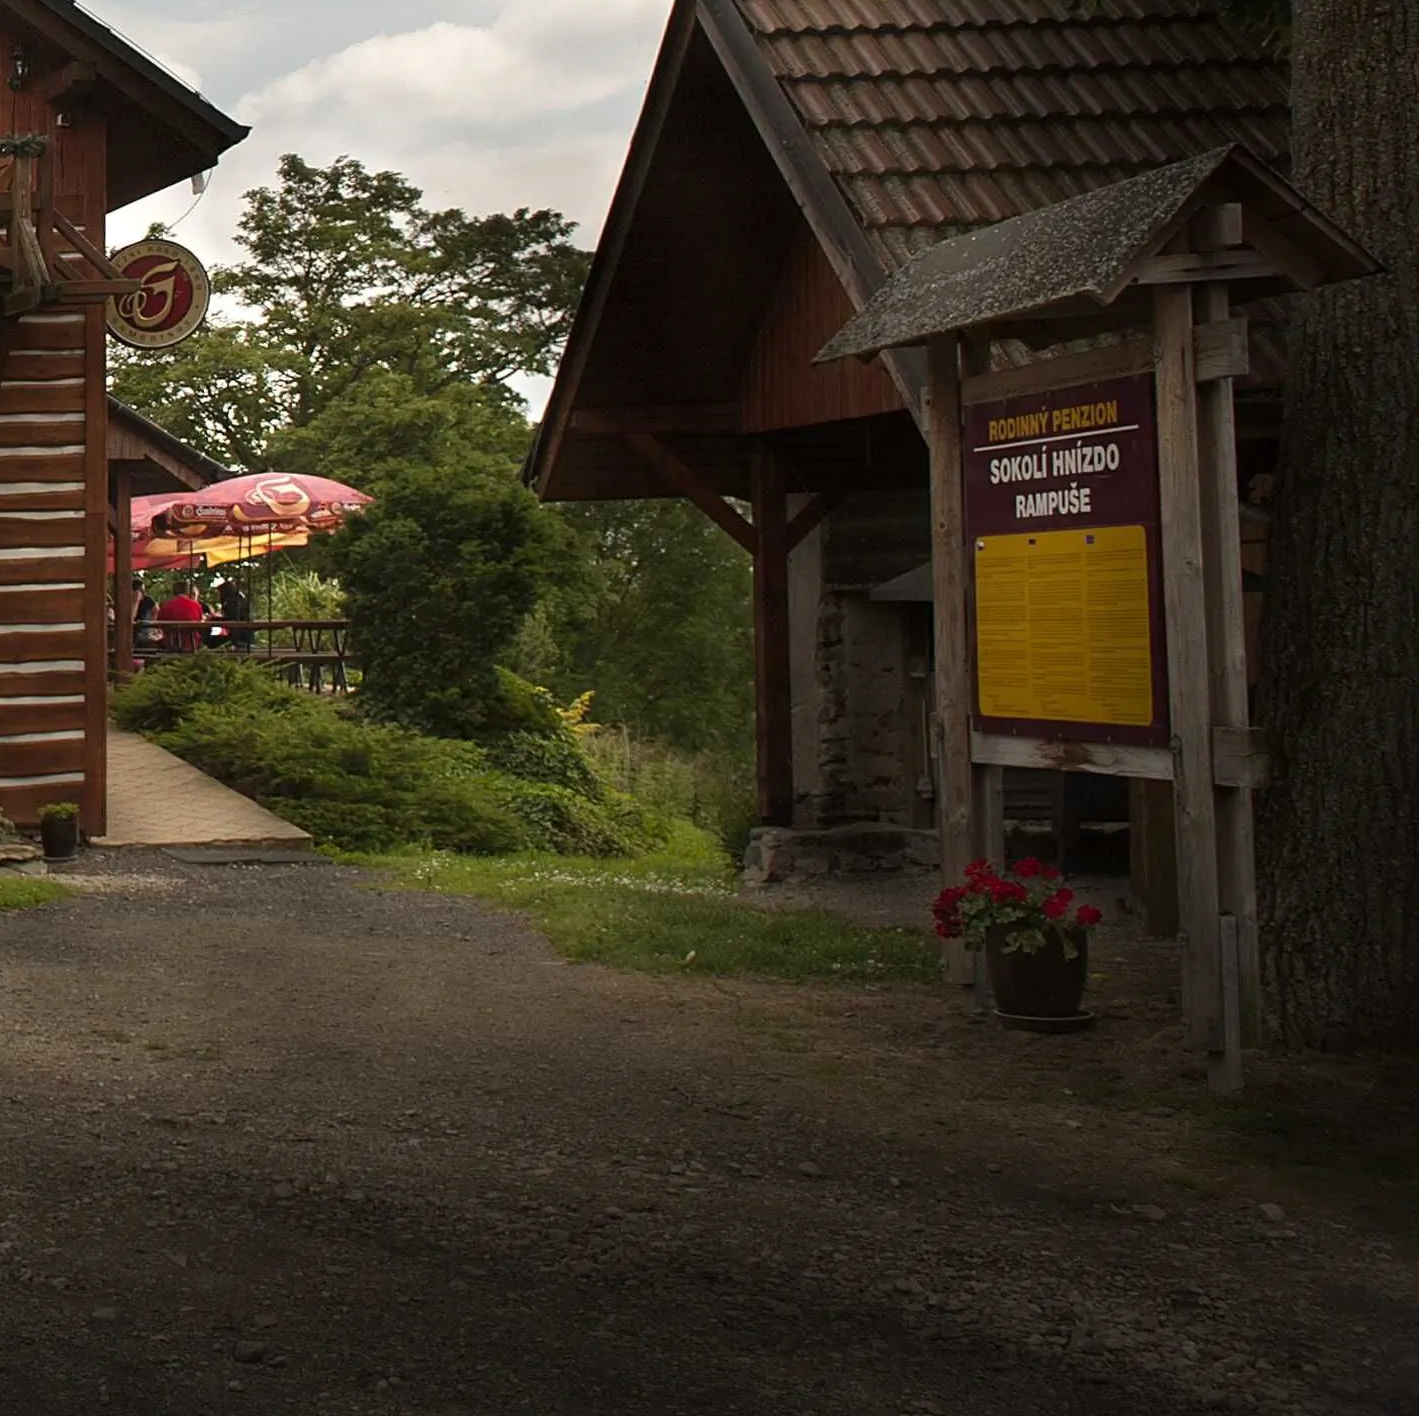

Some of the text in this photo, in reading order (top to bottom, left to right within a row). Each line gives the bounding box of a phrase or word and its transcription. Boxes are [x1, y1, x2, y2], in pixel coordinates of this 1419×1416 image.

[988, 399, 1119, 443] RODINNÝ PENZION
[990, 440, 1120, 485] SOKOLÍ HNÍZDO
[1015, 481, 1092, 519] RAMPUŠE
